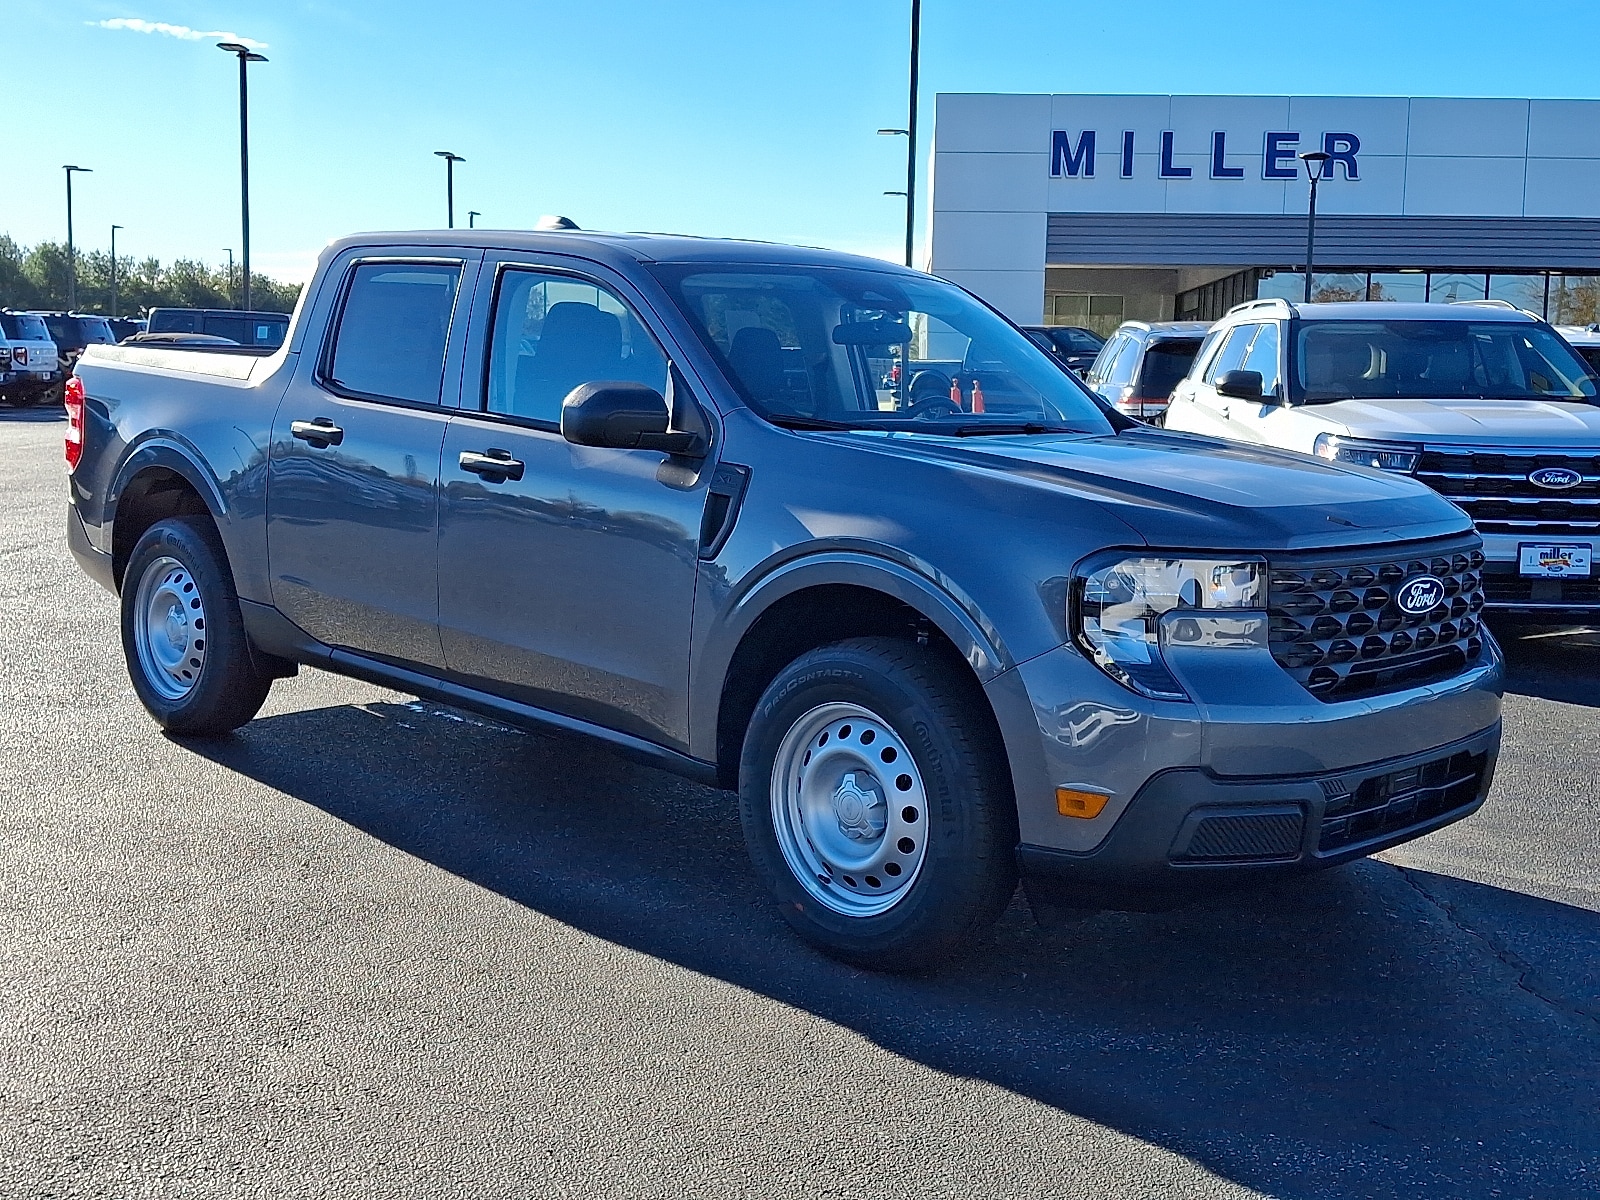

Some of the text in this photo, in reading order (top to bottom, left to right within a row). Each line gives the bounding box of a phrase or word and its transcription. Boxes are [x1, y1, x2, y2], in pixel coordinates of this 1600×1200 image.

[1050, 129, 1361, 179] MILLER
[1541, 471, 1570, 484] Ford
[1539, 546, 1574, 560] miller
[1407, 582, 1437, 609] Ford
